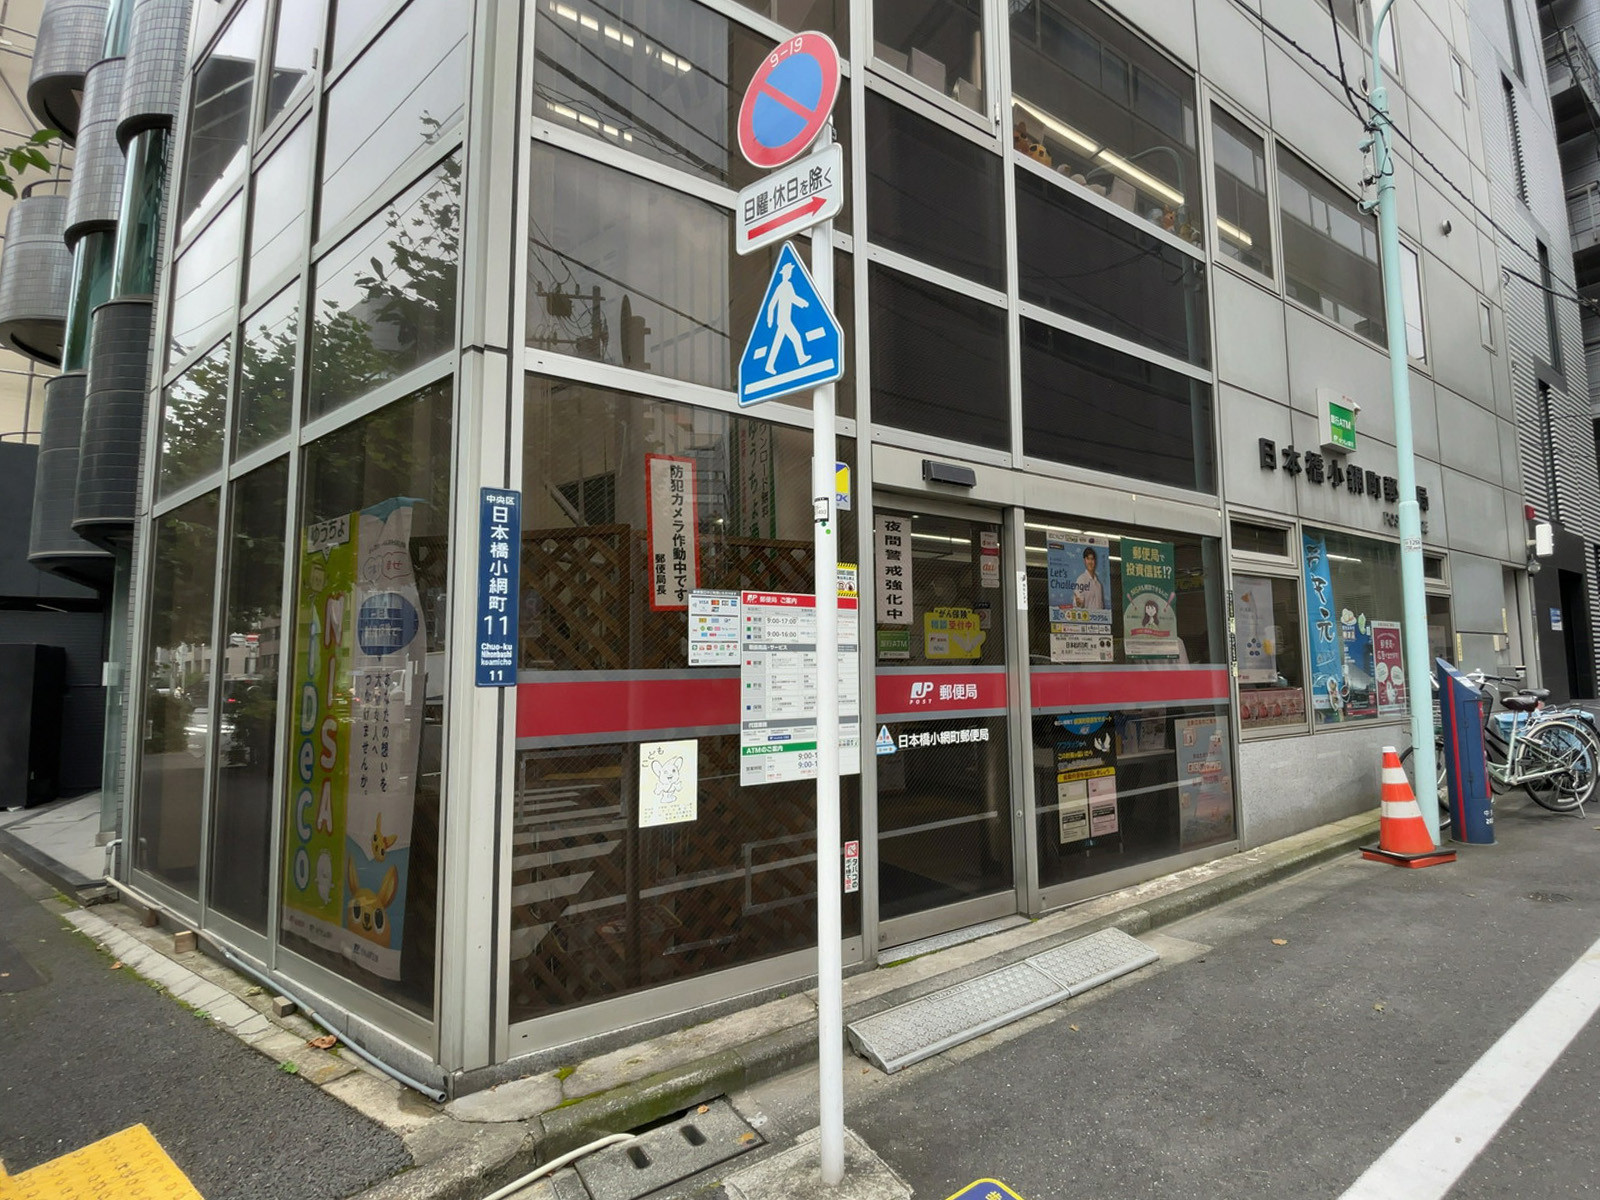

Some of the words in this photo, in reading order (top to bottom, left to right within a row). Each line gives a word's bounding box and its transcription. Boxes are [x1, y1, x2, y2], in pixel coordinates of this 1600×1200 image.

[769, 37, 803, 68] 9-19
[744, 166, 833, 222] 日曜・休日を除く
[1258, 438, 1429, 511] 日本橋小網町郵局
[486, 495, 515, 505] 中央区
[309, 520, 347, 546] ゆうちょ
[670, 465, 687, 602] 防犯カメラ作動中です
[489, 506, 510, 612] 日本橋小網町
[1132, 546, 1166, 563] 郵便局で
[655, 553, 667, 595] 郵便局長
[884, 520, 903, 620] 夜間警戒強化中
[1050, 567, 1068, 579] Let's
[1126, 562, 1172, 579] 投資信託!?
[1050, 579, 1091, 593] Challenge!
[484, 615, 509, 636] 11
[481, 642, 512, 651] Chuo-ku
[489, 670, 504, 681] 11
[939, 684, 978, 700] 郵便局
[315, 591, 345, 836] NISA
[898, 728, 990, 749] 日本橋小網町郵便局
